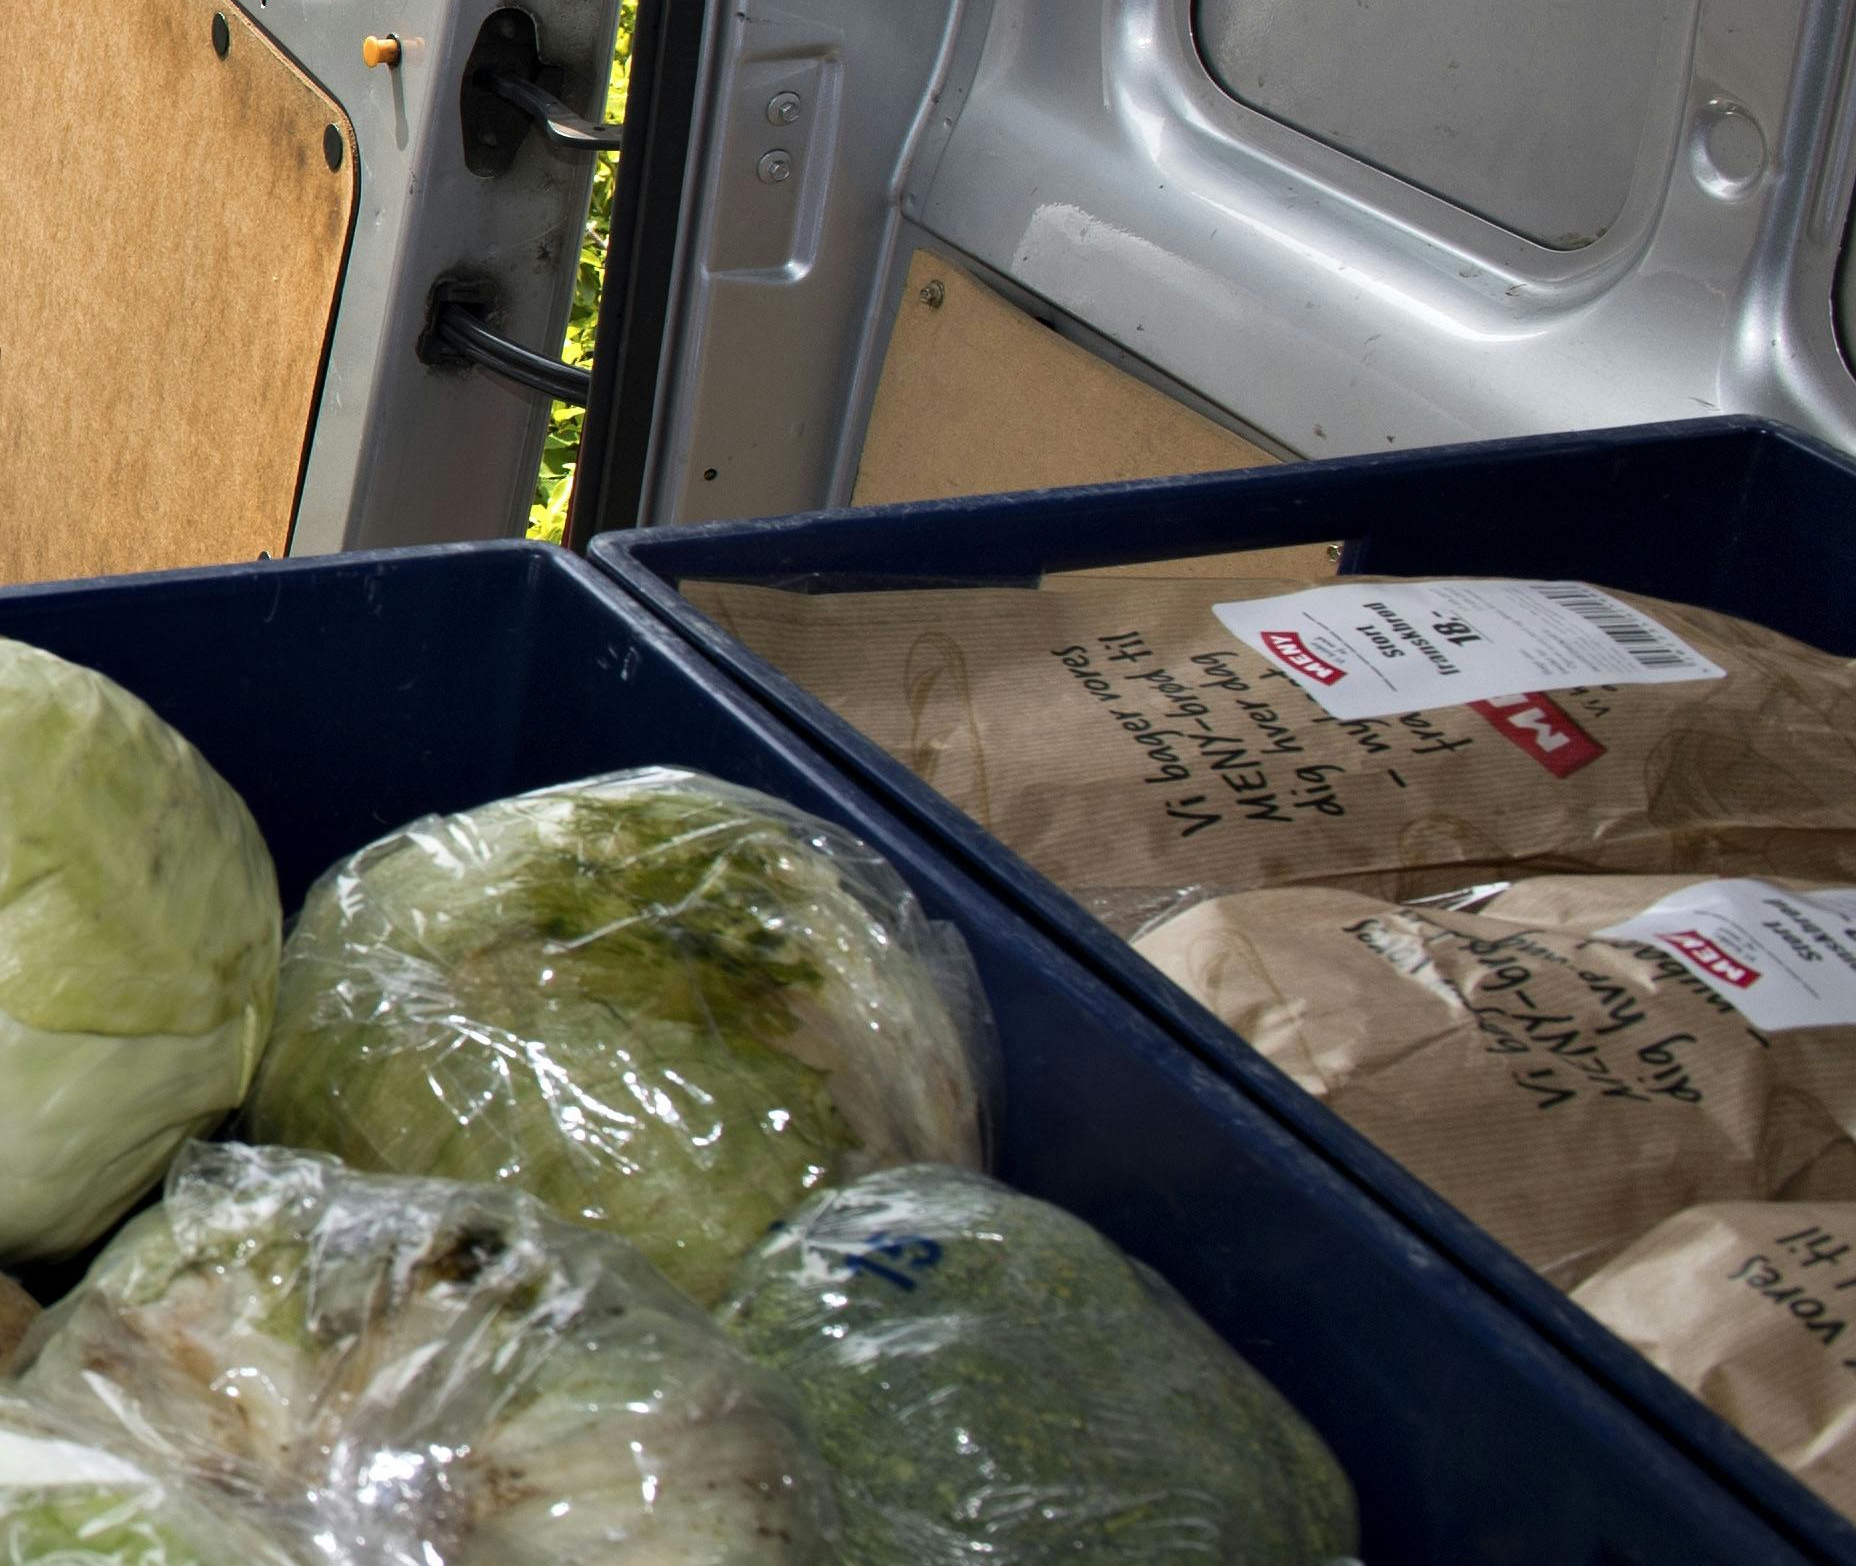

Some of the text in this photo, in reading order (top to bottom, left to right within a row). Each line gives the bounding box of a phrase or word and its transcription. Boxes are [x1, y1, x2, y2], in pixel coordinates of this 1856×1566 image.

[1097, 631, 1153, 663] til
[1270, 635, 1335, 679] MENY
[1356, 623, 1406, 659] Stort
[1050, 644, 1223, 837] Vi bager vores
[1191, 650, 1346, 816] dig hver dag
[1512, 1068, 1576, 1110] Vi
[1637, 1032, 1702, 1102] dig
[1776, 1227, 1850, 1267] til
[1728, 1255, 1845, 1345] vores
